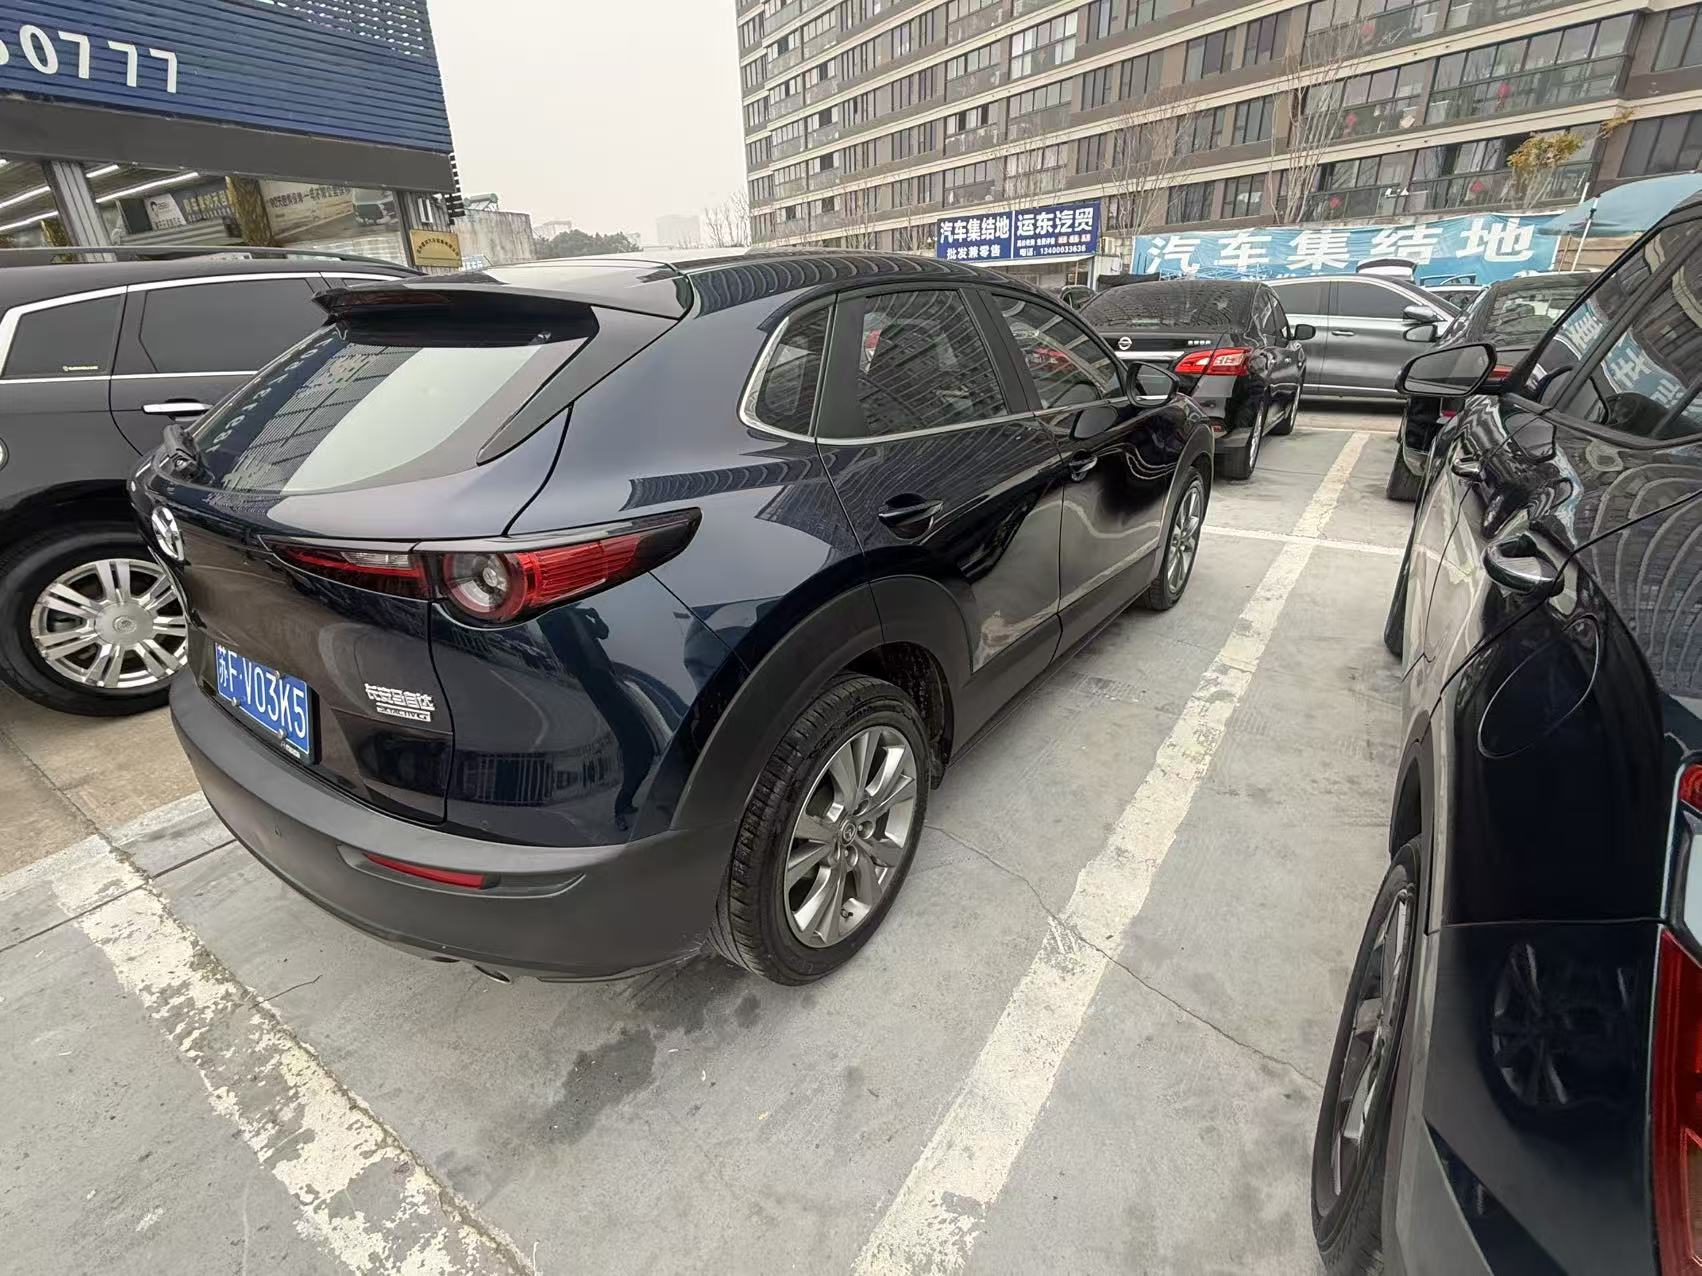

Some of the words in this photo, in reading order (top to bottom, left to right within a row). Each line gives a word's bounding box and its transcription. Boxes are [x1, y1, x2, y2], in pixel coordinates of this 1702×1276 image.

[0, 24, 178, 94] 0777
[940, 215, 1009, 244] 汽车集结地
[1017, 207, 1094, 236] 运东汽贸
[946, 244, 1001, 260] 批发兼零售
[1147, 217, 1534, 274] 汽车集结地
